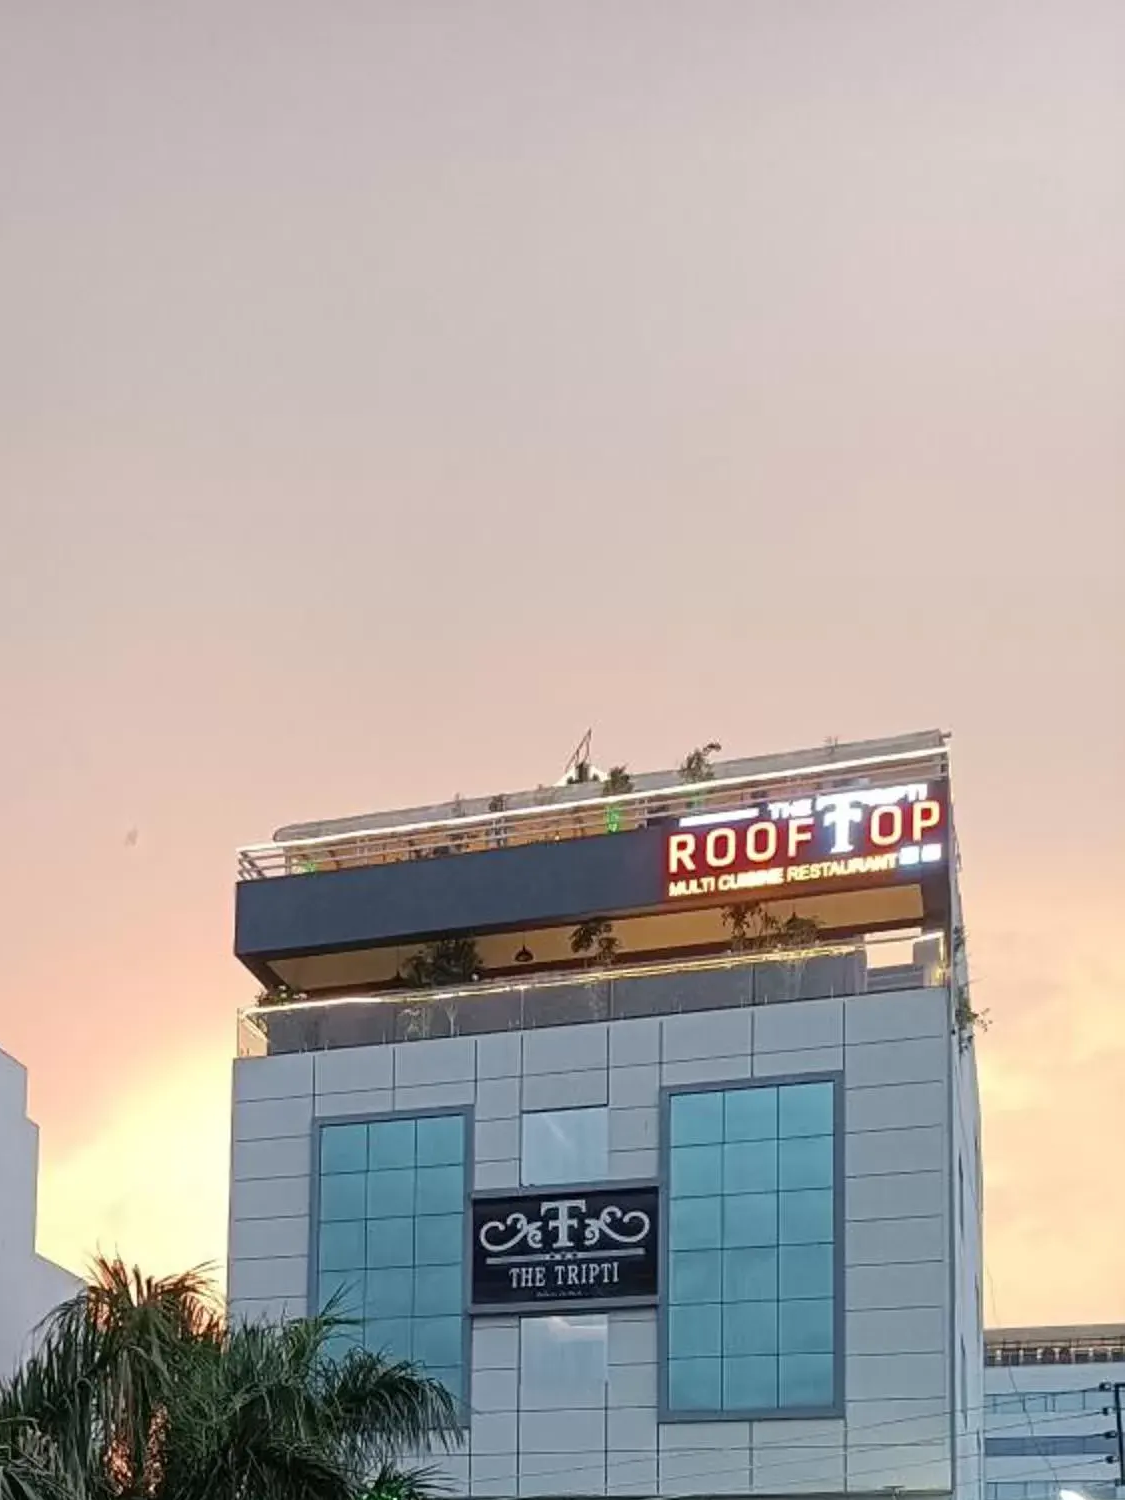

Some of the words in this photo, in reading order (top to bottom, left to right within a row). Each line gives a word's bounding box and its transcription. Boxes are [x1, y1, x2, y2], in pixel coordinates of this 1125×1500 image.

[668, 799, 940, 873] ROOFTOP
[668, 876, 715, 896] MULTI
[786, 852, 897, 883] RESTAURANT
[508, 1267, 546, 1289] THE
[554, 1261, 620, 1286] TRIPTI
